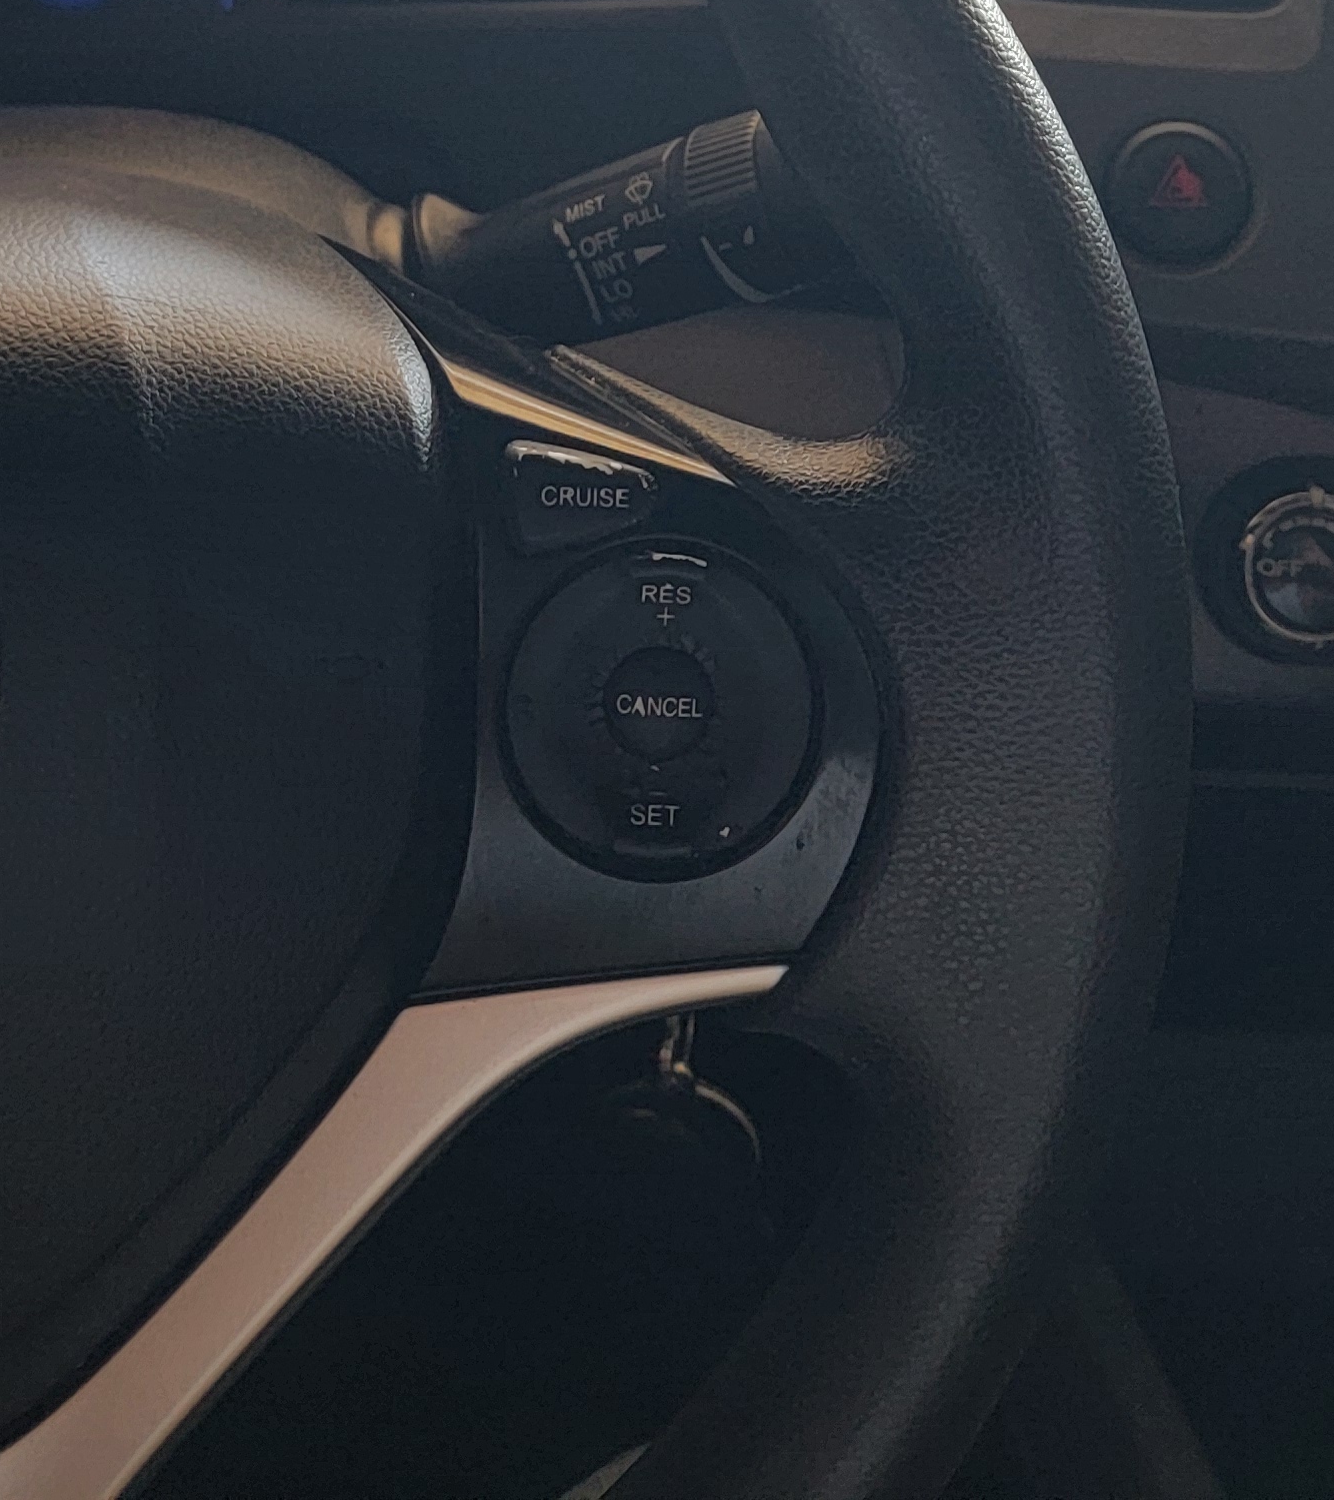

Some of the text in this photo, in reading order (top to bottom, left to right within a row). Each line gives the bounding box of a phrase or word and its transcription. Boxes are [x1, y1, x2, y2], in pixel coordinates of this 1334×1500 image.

[566, 195, 605, 223] MIST
[622, 203, 666, 231] PULL
[578, 226, 620, 259] OFF
[592, 253, 627, 280] INT
[601, 278, 633, 301] LO
[540, 486, 629, 509] CRUISE
[641, 584, 692, 605] RES
[616, 694, 703, 718] CANCEL
[630, 805, 680, 826] SET
